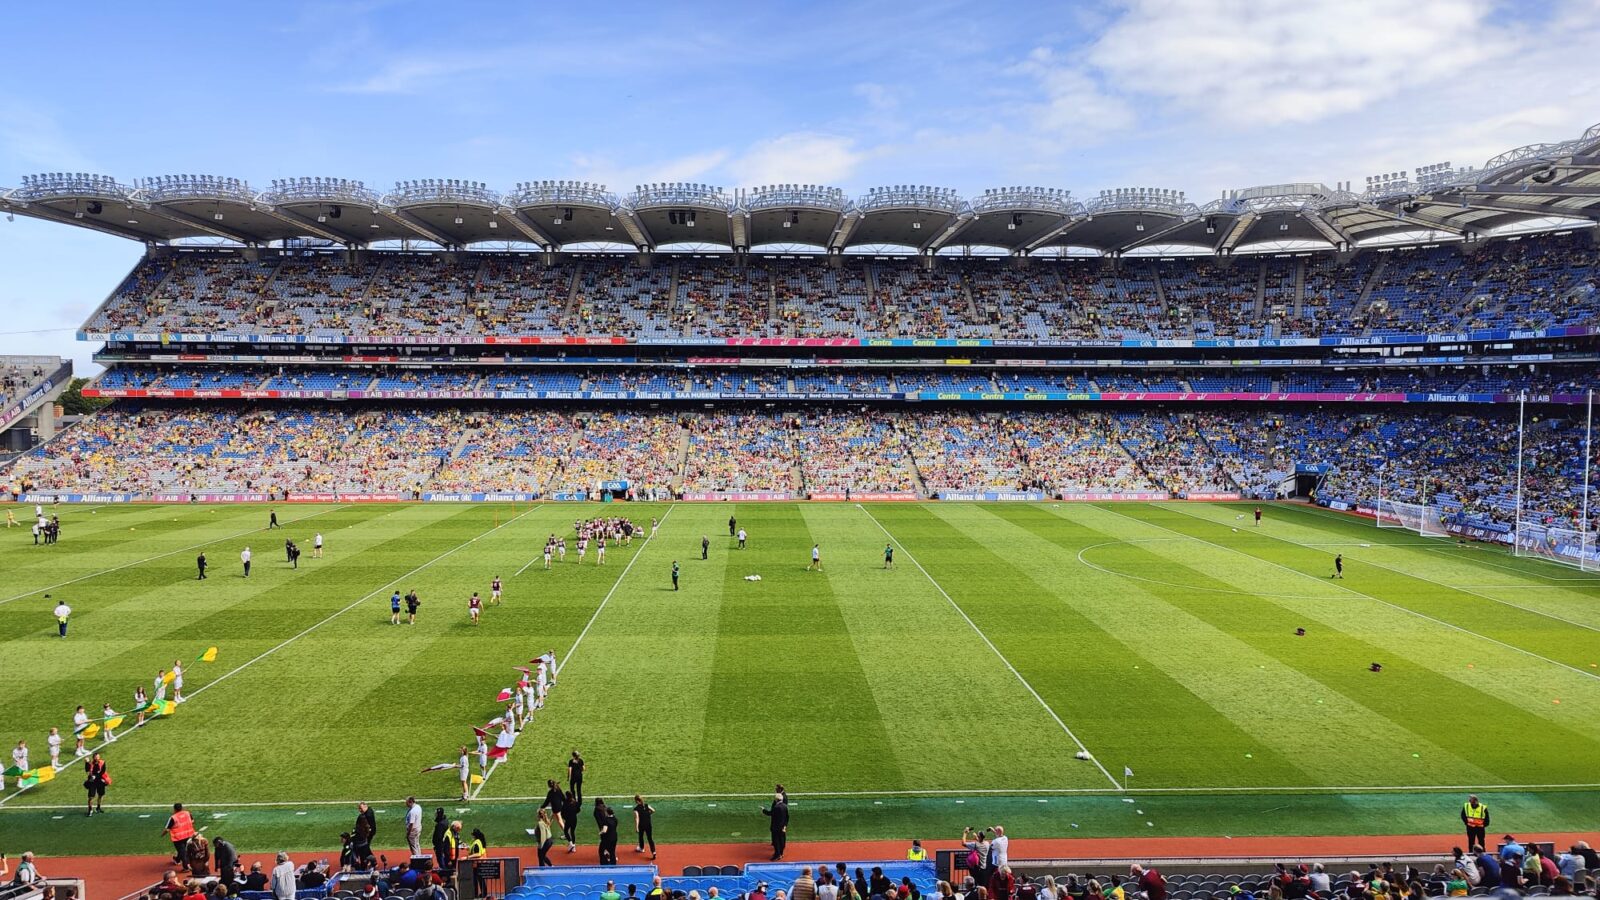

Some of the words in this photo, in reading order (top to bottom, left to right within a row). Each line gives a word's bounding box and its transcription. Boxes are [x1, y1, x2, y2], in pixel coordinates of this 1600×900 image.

[1426, 334, 1456, 342] Allianz
[1509, 330, 1534, 339] Allianz
[23, 388, 44, 410] Allianz
[11, 407, 20, 416] AIB
[1496, 533, 1508, 541] AIB
